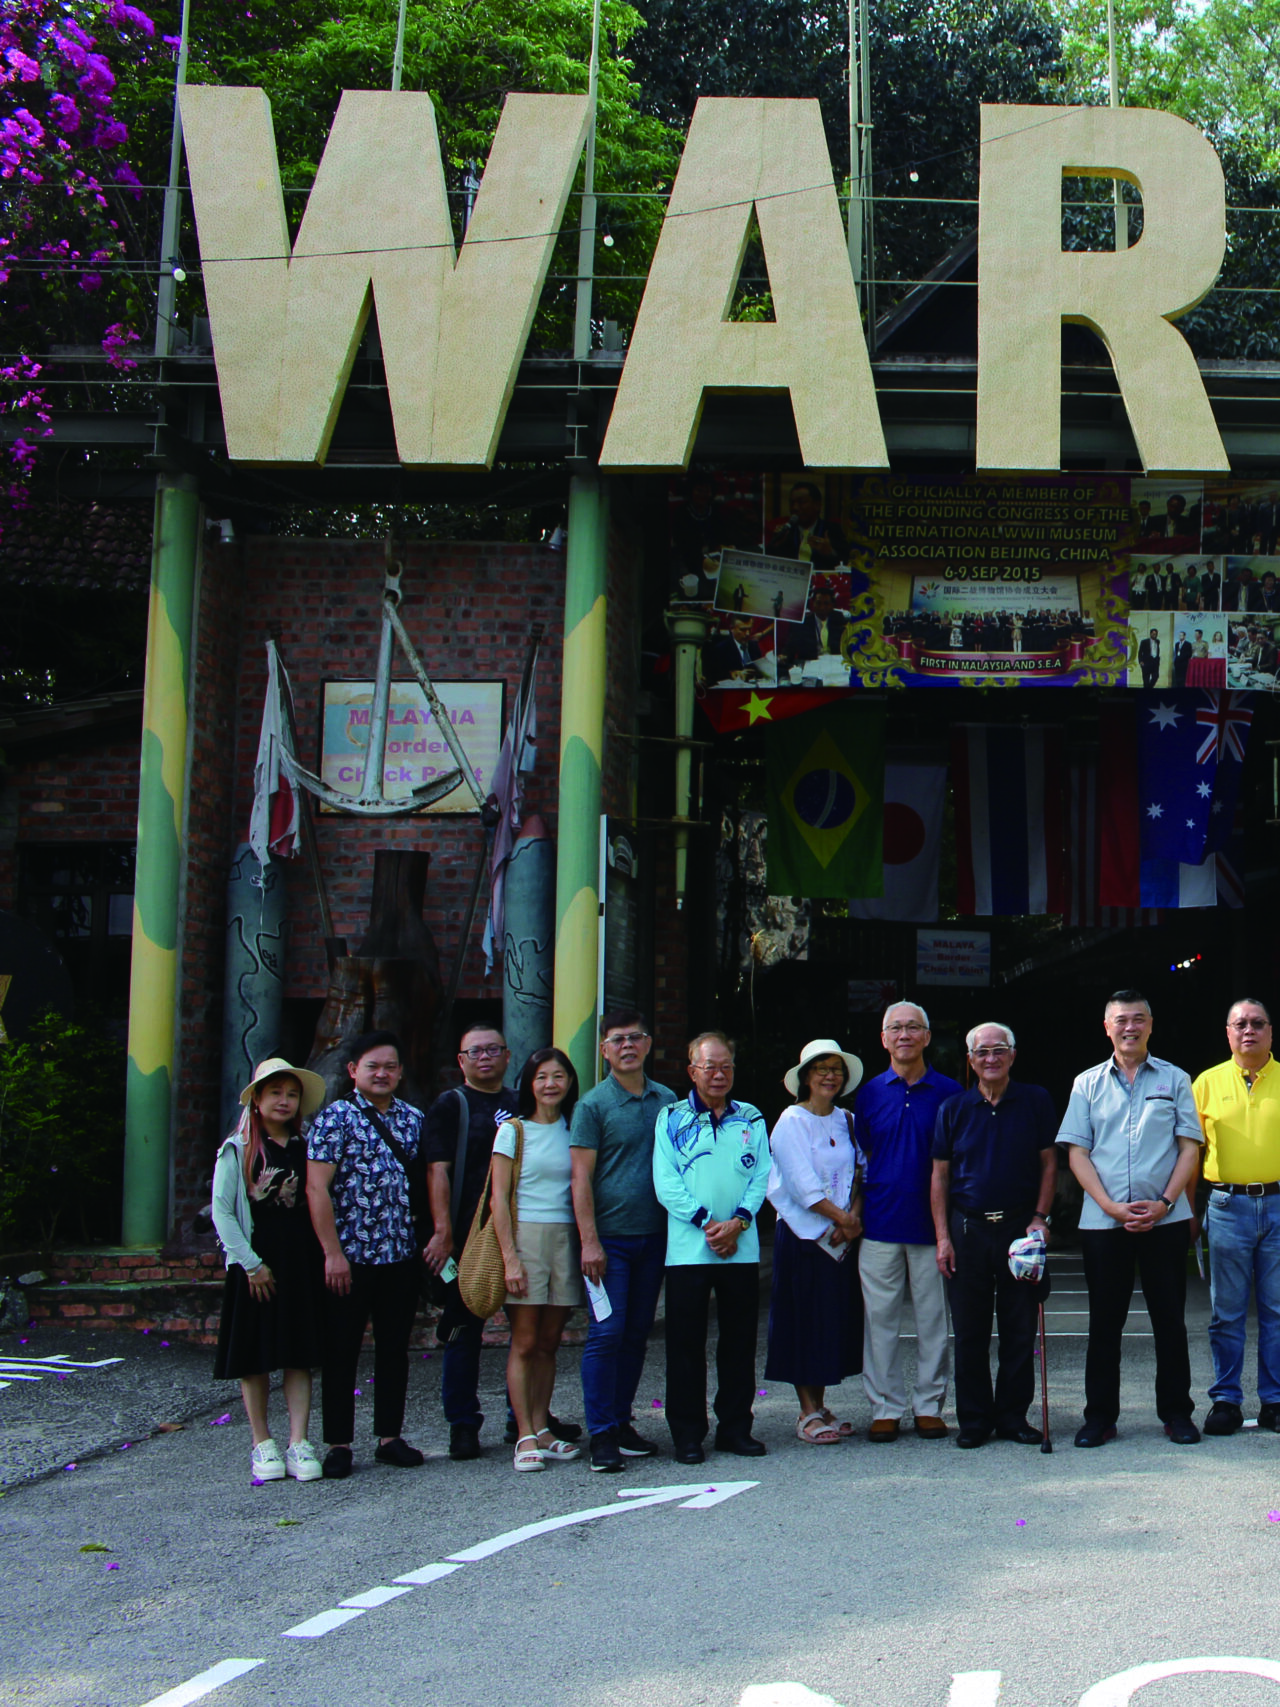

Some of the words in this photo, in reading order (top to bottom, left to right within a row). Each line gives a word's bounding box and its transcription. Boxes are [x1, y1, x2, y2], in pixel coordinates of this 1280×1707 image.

[176, 84, 1230, 476] WAR
[891, 485, 981, 500] OFFICIALLY
[986, 488, 998, 500] A
[1002, 488, 1069, 500] MEMBER
[1072, 489, 1095, 501] OF
[863, 505, 893, 518] THE
[898, 506, 983, 520] FOUNDING
[987, 507, 1070, 521] CONGRESS
[1073, 508, 1095, 521] OF
[1098, 508, 1130, 522] THE
[868, 525, 1000, 539] INTERNATIONAL
[1003, 528, 1045, 540] WWII
[1049, 528, 1117, 541] MUSEUM
[878, 545, 986, 559] ASSOCIATION
[990, 547, 1051, 560] BEIJING
[945, 566, 967, 579] 6-9
[972, 567, 998, 580] SEP
[1004, 567, 1041, 581] 2015
[920, 656, 946, 668] FIRST
[948, 659, 959, 670] IN
[961, 661, 1010, 671] MALAYSIA
[1013, 661, 1034, 670] AND
[1037, 658, 1062, 669] S.E.A
[349, 708, 476, 726] MLAYIA
[382, 737, 452, 754] order
[338, 766, 412, 783] Chck
[933, 940, 975, 949] MALAYA
